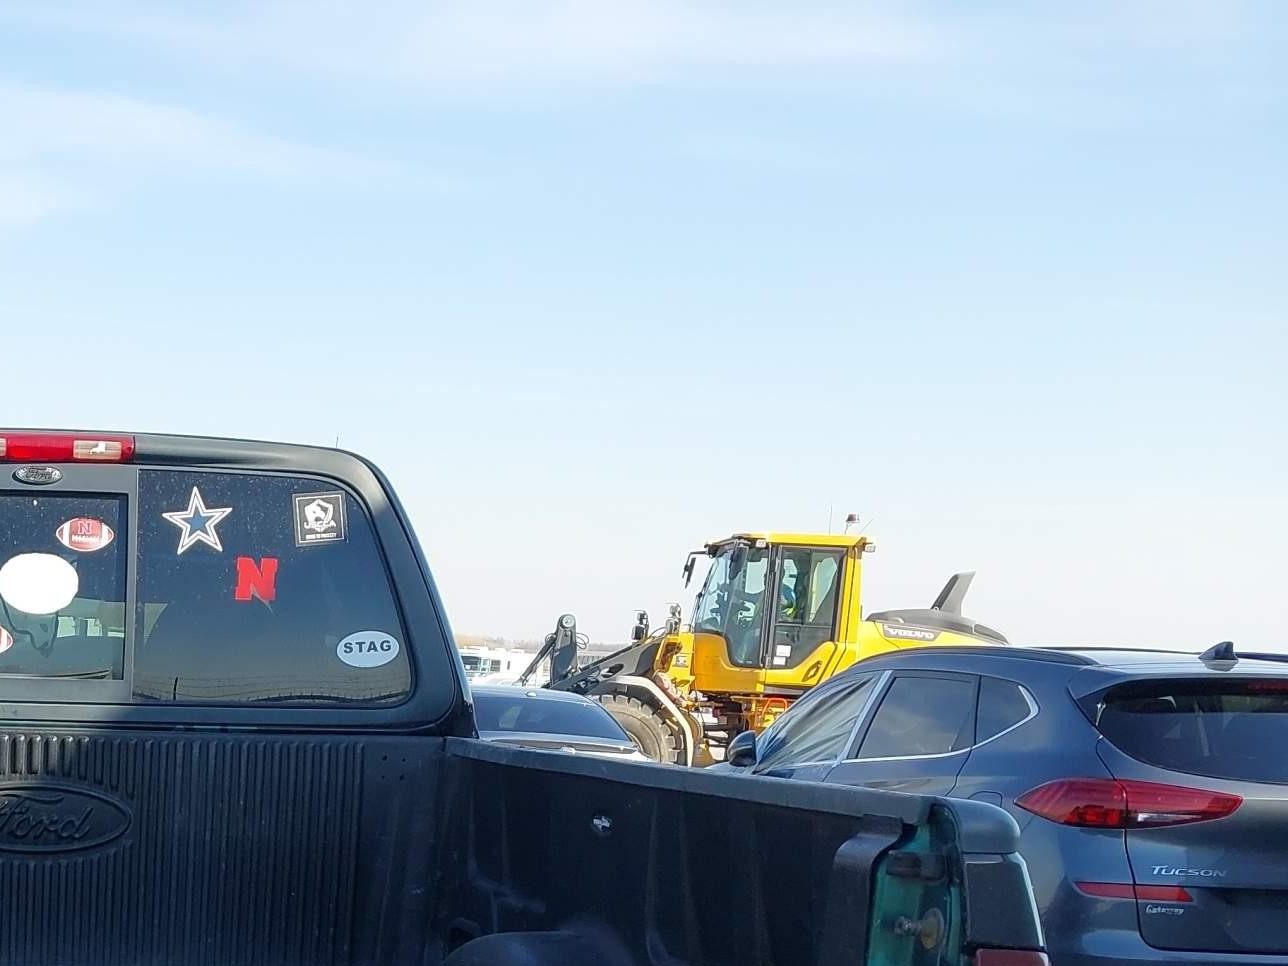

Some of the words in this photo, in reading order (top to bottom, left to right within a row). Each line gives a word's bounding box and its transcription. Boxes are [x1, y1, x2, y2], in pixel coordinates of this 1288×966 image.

[77, 520, 93, 535] N
[233, 554, 279, 602] N
[887, 628, 935, 639] VOLVO
[343, 639, 392, 654] STAG
